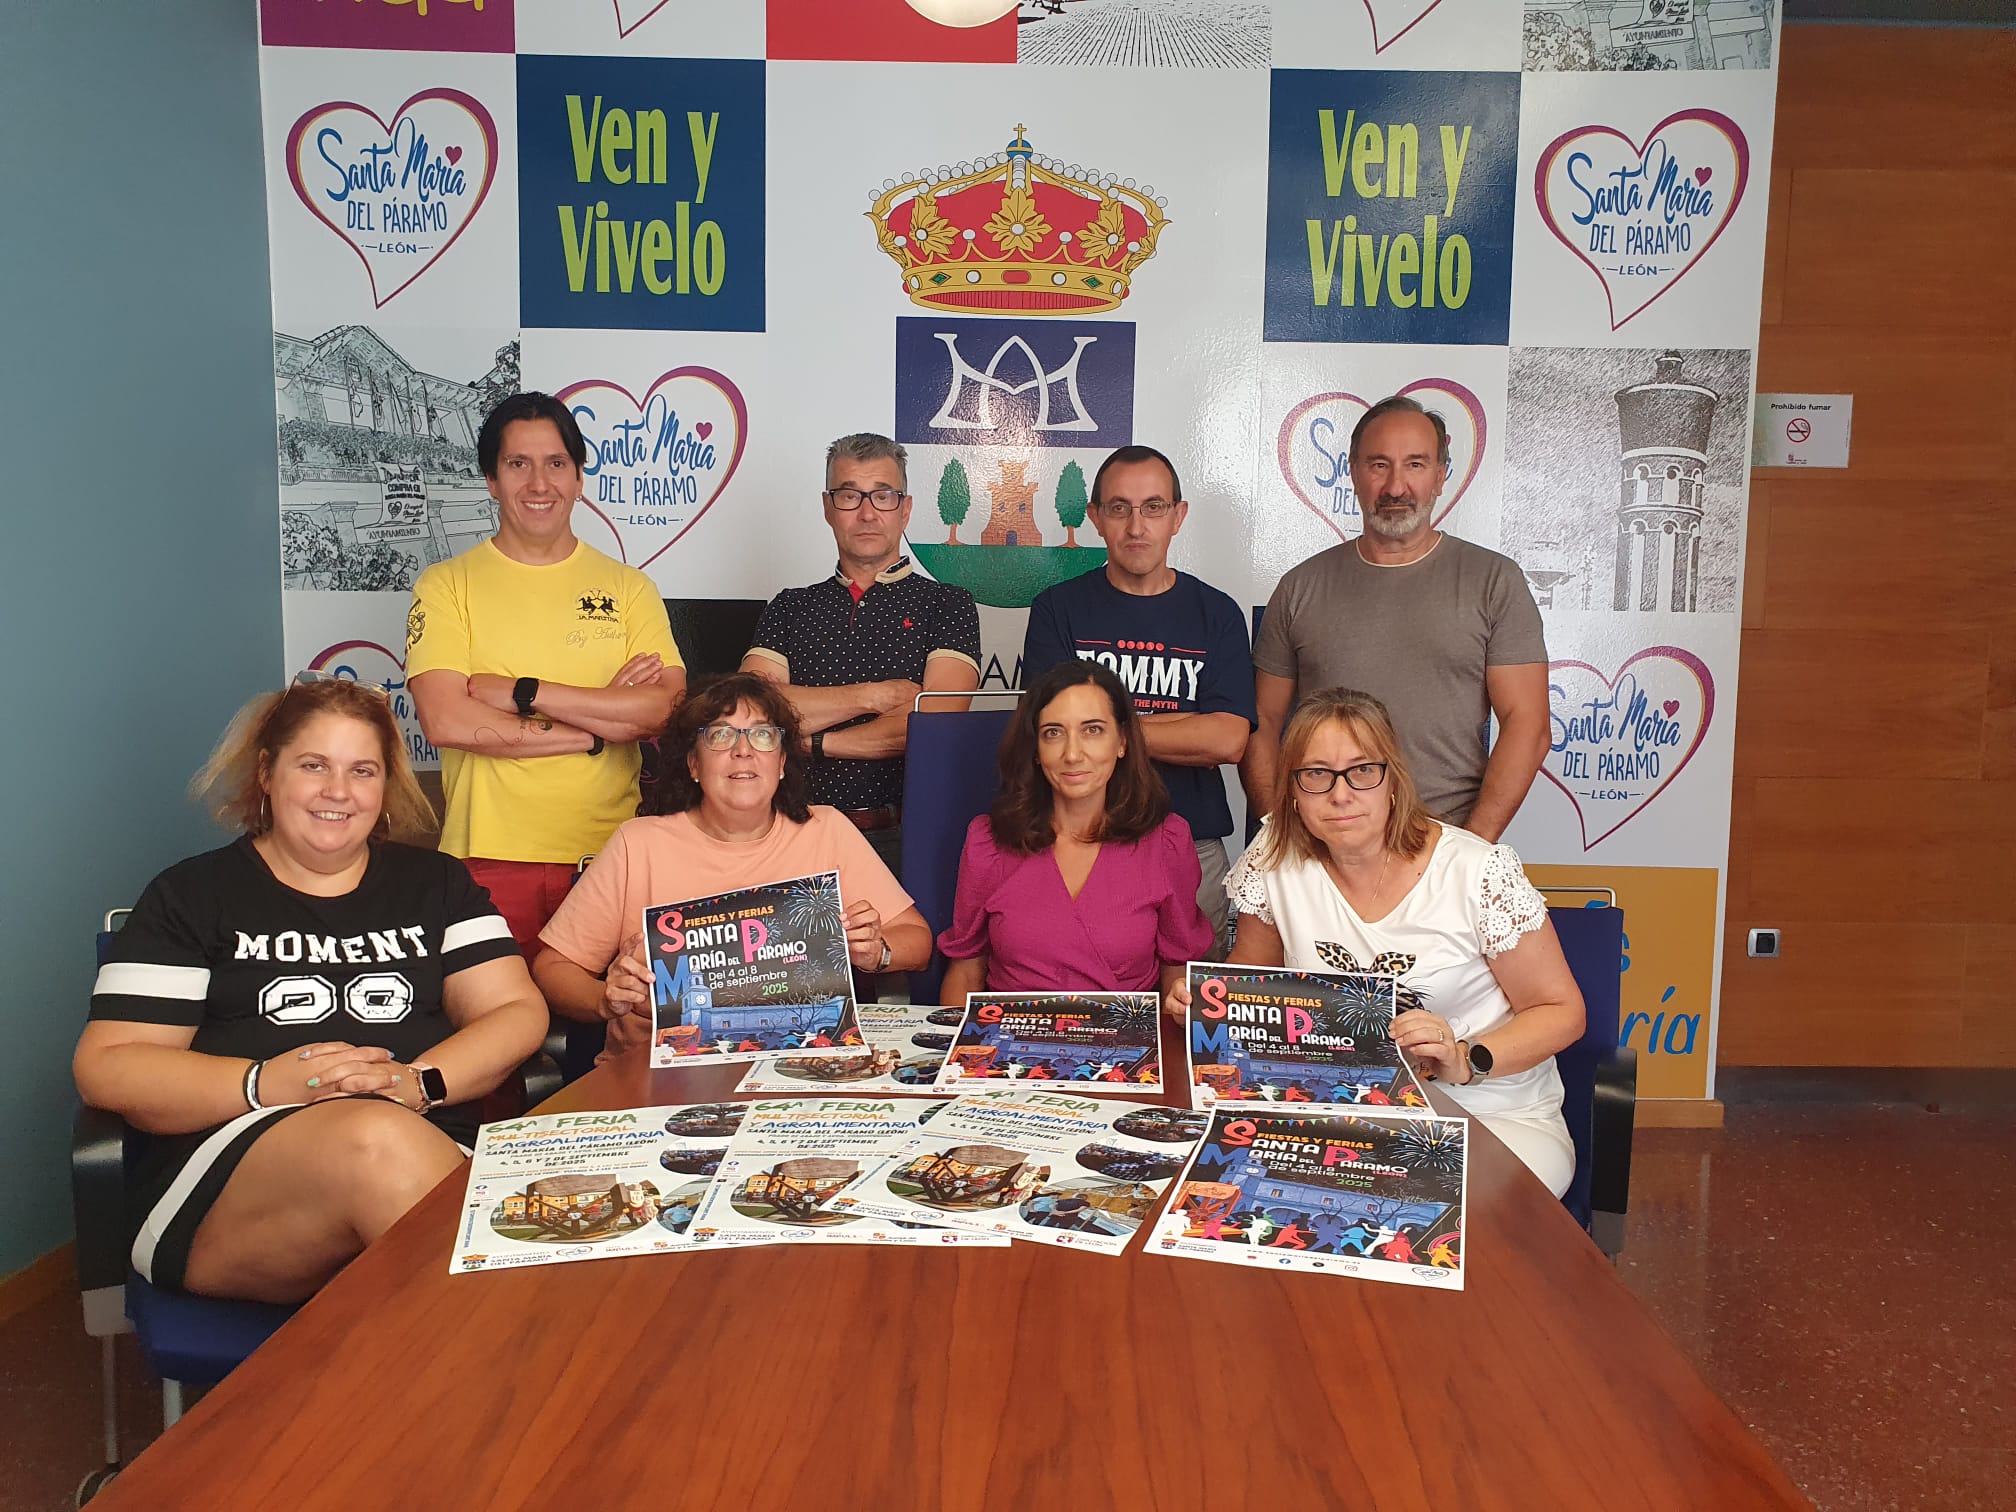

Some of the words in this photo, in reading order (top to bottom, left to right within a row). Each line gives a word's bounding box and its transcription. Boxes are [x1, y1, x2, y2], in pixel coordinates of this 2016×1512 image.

[566, 95, 667, 184] Ven
[687, 112, 719, 203] y
[317, 128, 396, 201] Santa
[1319, 109, 1419, 198] Ven
[1440, 125, 1471, 217] y
[1567, 153, 1642, 225] Santa
[347, 200, 375, 230] DEL
[384, 197, 447, 233] PÁRAMO
[1590, 224, 1616, 253] DEL
[1626, 219, 1690, 255] PÁRAMO
[379, 242, 417, 254] LEÓN
[558, 201, 726, 296] Vivelo
[1306, 215, 1472, 309] Vivelo
[1619, 264, 1658, 276] LEÓN
[599, 474, 625, 503] DEL
[634, 471, 697, 505] PÁRAMO
[1333, 487, 1359, 515] DEL
[630, 514, 667, 525] LEÓN
[1134, 699, 1150, 708] THE
[1152, 700, 1178, 709] MYTH
[1563, 751, 1589, 778] DEL
[1598, 747, 1660, 781] PÁRAMO
[1591, 789, 1628, 800] LEÓN
[685, 914, 726, 927] FIESTAS
[729, 911, 736, 919] Y
[738, 905, 775, 919] FERIAS
[234, 924, 428, 963] MOMENT
[728, 957, 741, 966] DEL
[709, 969, 726, 981] Del
[728, 969, 735, 978] 4
[738, 966, 748, 976] al
[750, 965, 758, 975] 8
[709, 980, 724, 990] de
[726, 970, 788, 988] septiembre
[762, 982, 789, 996] 2025
[1228, 993, 1270, 1004] FIESTAS
[1273, 996, 1281, 1004] Y
[1284, 997, 1322, 1008] FERIAS
[860, 1006, 908, 1014] ERIA
[1619, 986, 1700, 1054] ría
[1266, 1048, 1333, 1057] septiembre
[819, 1102, 896, 1112] FERIA
[961, 1098, 1088, 1118] MULTISECTORIAL
[1025, 1094, 1100, 1112] FERIA
[556, 1113, 638, 1128] FERIA
[766, 1121, 917, 1129] AGROALIMENTARIA
[966, 1107, 1109, 1130] AGROALIMENTARIA
[487, 1125, 635, 1142] MULTISECTORIAL
[501, 1130, 666, 1149] AGROALIMENTARIA
[1257, 1133, 1310, 1144] FIESTAS
[1313, 1136, 1322, 1144] Y
[1326, 1138, 1375, 1150] FERIAS
[569, 1151, 630, 1161] SEPTIEMBRE
[1270, 1160, 1293, 1168] Del
[1291, 1167, 1375, 1181] septiembre
[1336, 1178, 1373, 1188] 2025
